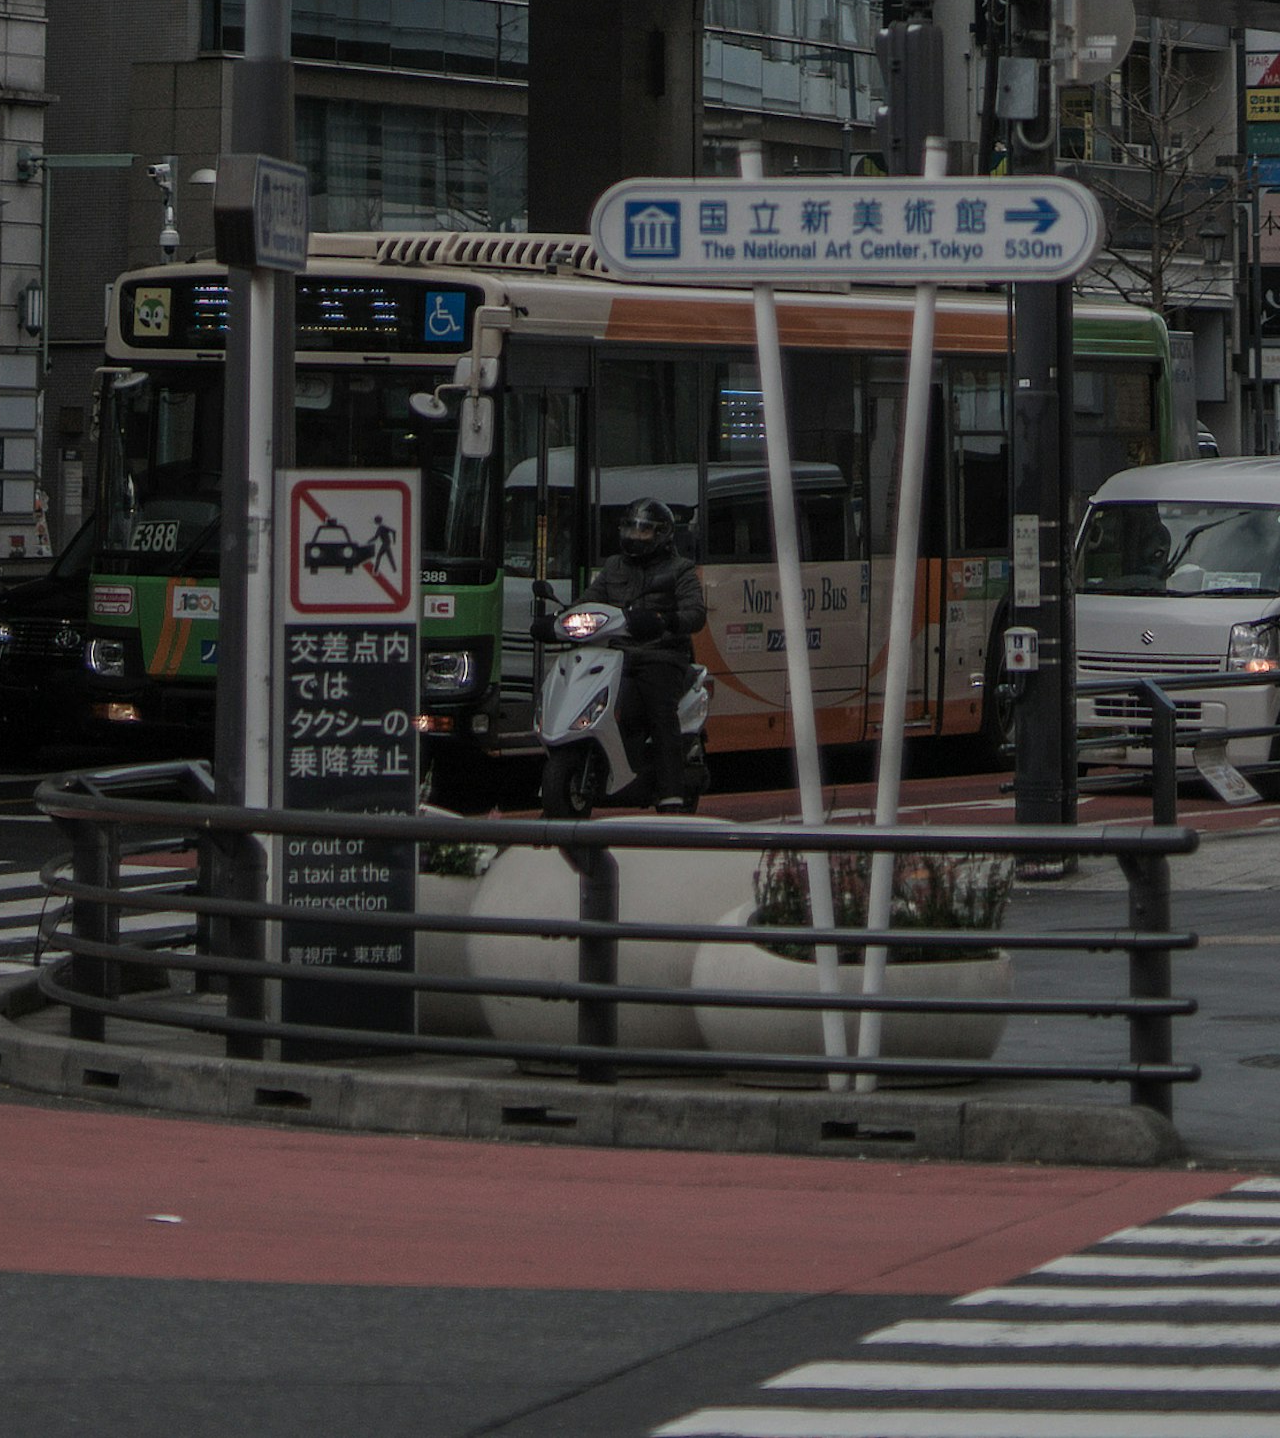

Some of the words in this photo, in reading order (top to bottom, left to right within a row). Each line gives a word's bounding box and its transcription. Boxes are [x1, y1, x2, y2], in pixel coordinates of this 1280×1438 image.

[1247, 56, 1269, 66] HAIR
[699, 198, 987, 234] 国立新美術館
[701, 240, 736, 259] The
[743, 240, 817, 259] National
[825, 240, 852, 259] Art
[1004, 239, 1063, 259] 530m
[131, 523, 178, 552] E388
[821, 577, 847, 610] Bus
[289, 631, 410, 664] 交差点内
[290, 670, 350, 700] では
[290, 708, 410, 739] タクシーの
[289, 744, 411, 778] 乗降禁止
[288, 840, 305, 857] or
[312, 837, 341, 856] out
[346, 837, 365, 855] of
[288, 868, 299, 885] a
[303, 862, 335, 885] taxi
[340, 866, 358, 884] at
[361, 862, 390, 883] the
[288, 891, 388, 911] intersection
